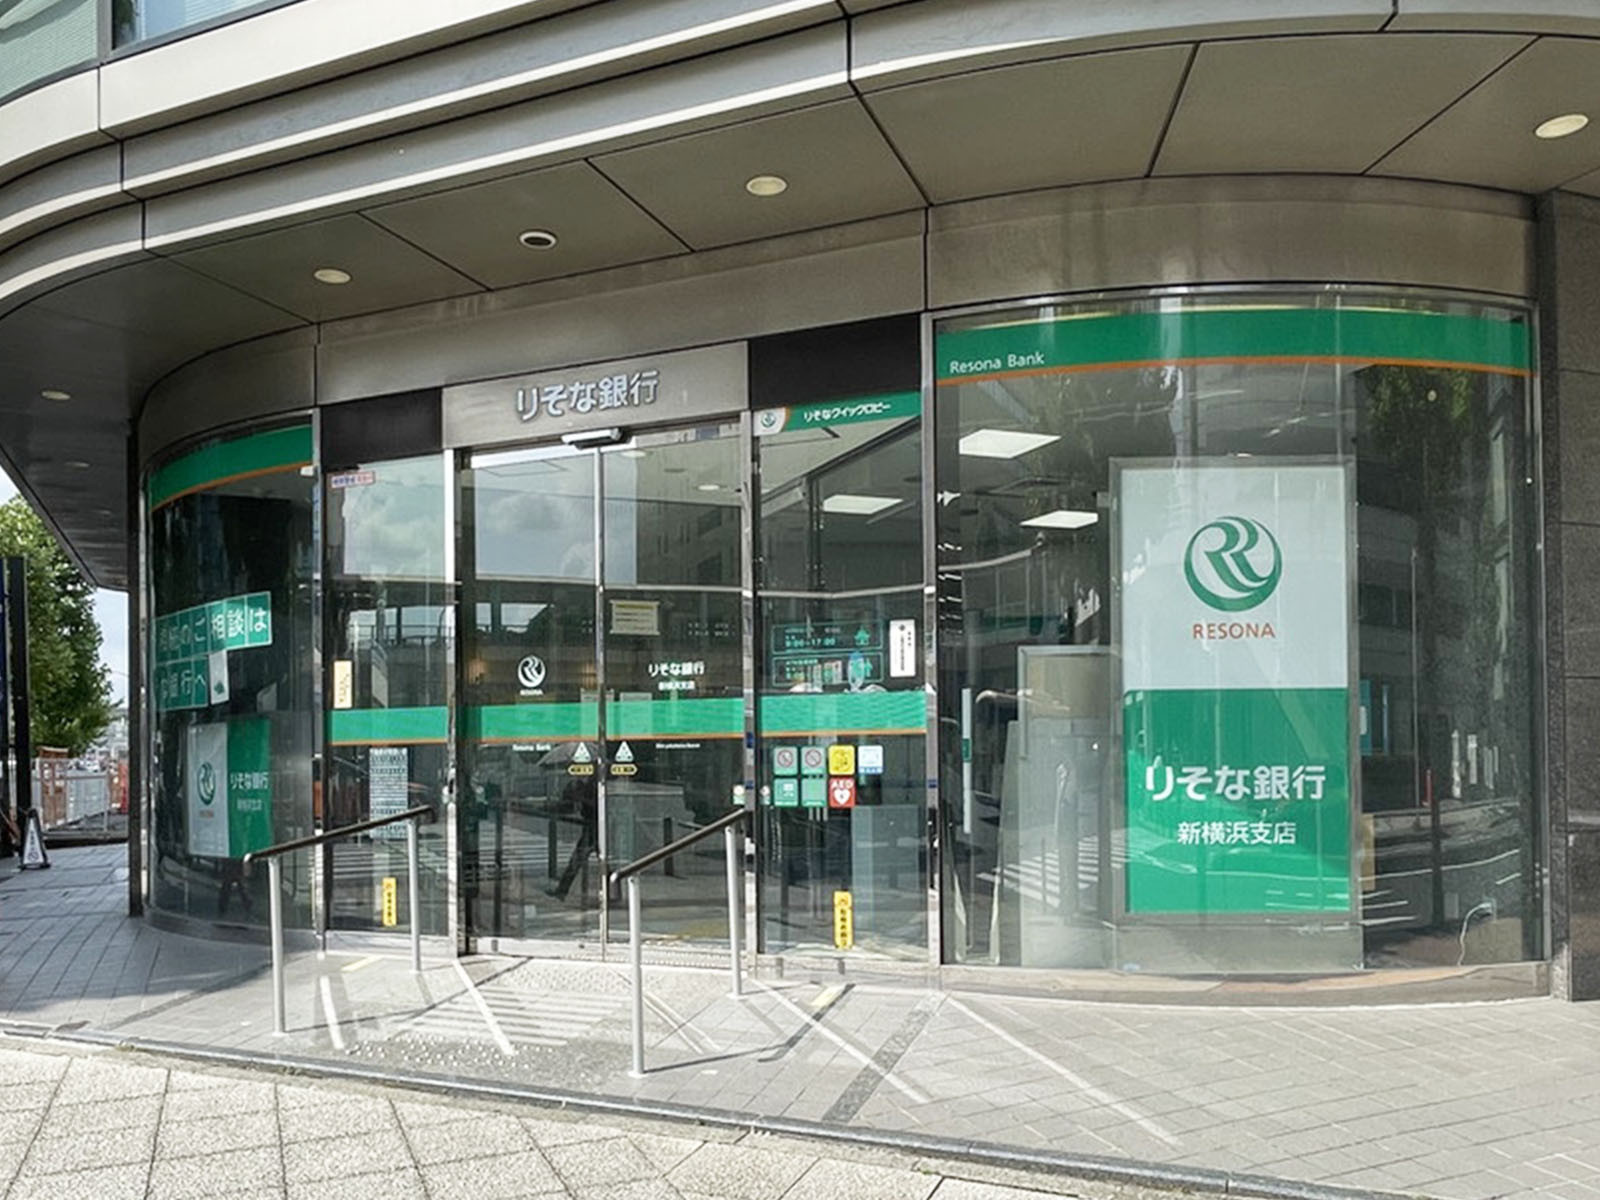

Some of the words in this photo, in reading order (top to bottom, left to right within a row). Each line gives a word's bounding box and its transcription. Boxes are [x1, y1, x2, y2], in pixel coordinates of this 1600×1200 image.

[949, 358, 1002, 374] Resona
[1007, 351, 1045, 368] Bank
[516, 370, 660, 421] りそな銀行
[1192, 623, 1276, 640] RESONA
[1145, 764, 1326, 801] りそな銀行
[1177, 821, 1296, 845] 新横浜支店
